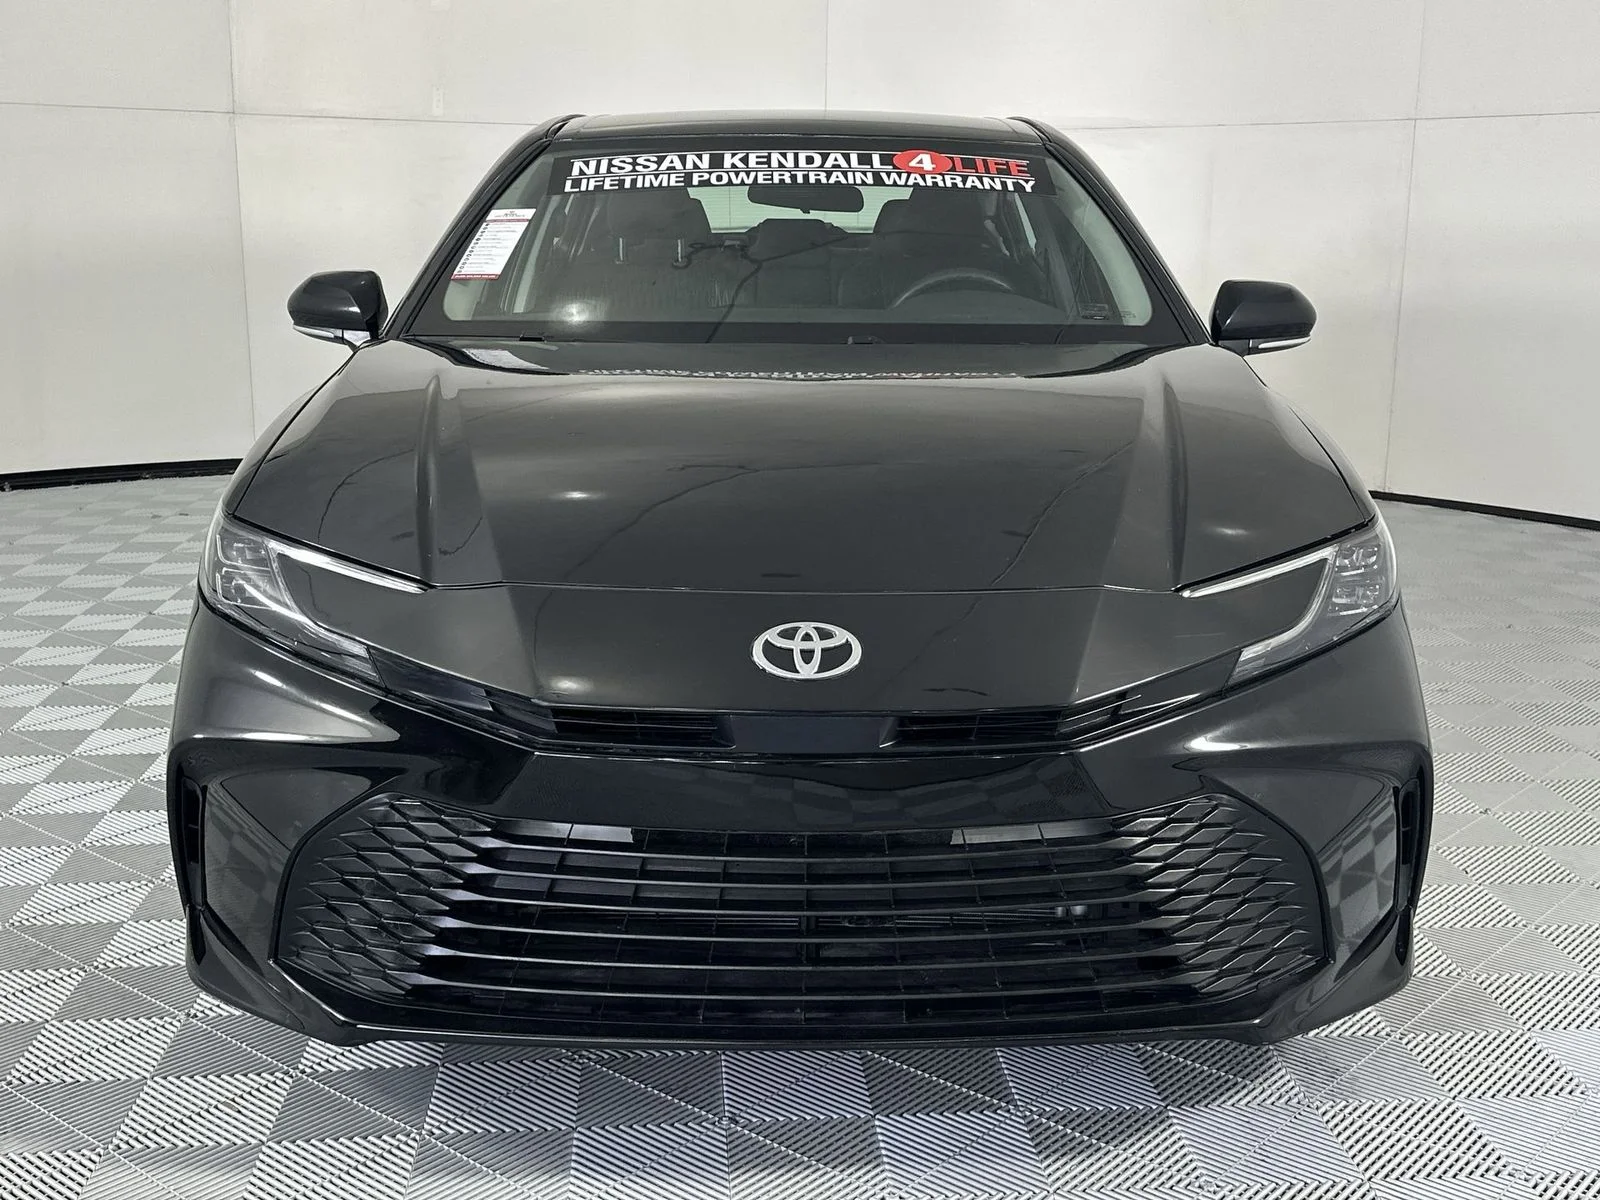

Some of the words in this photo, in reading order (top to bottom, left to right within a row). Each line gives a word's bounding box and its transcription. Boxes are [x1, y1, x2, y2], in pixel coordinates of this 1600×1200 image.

[571, 153, 710, 176] NISSAN
[724, 151, 893, 169] KENDALL
[908, 153, 936, 171] 4
[954, 157, 1031, 176] LIFE
[564, 173, 685, 192] LIFETIME
[692, 171, 874, 186] POWERTRAIN
[880, 173, 1036, 192] WARRANTY
